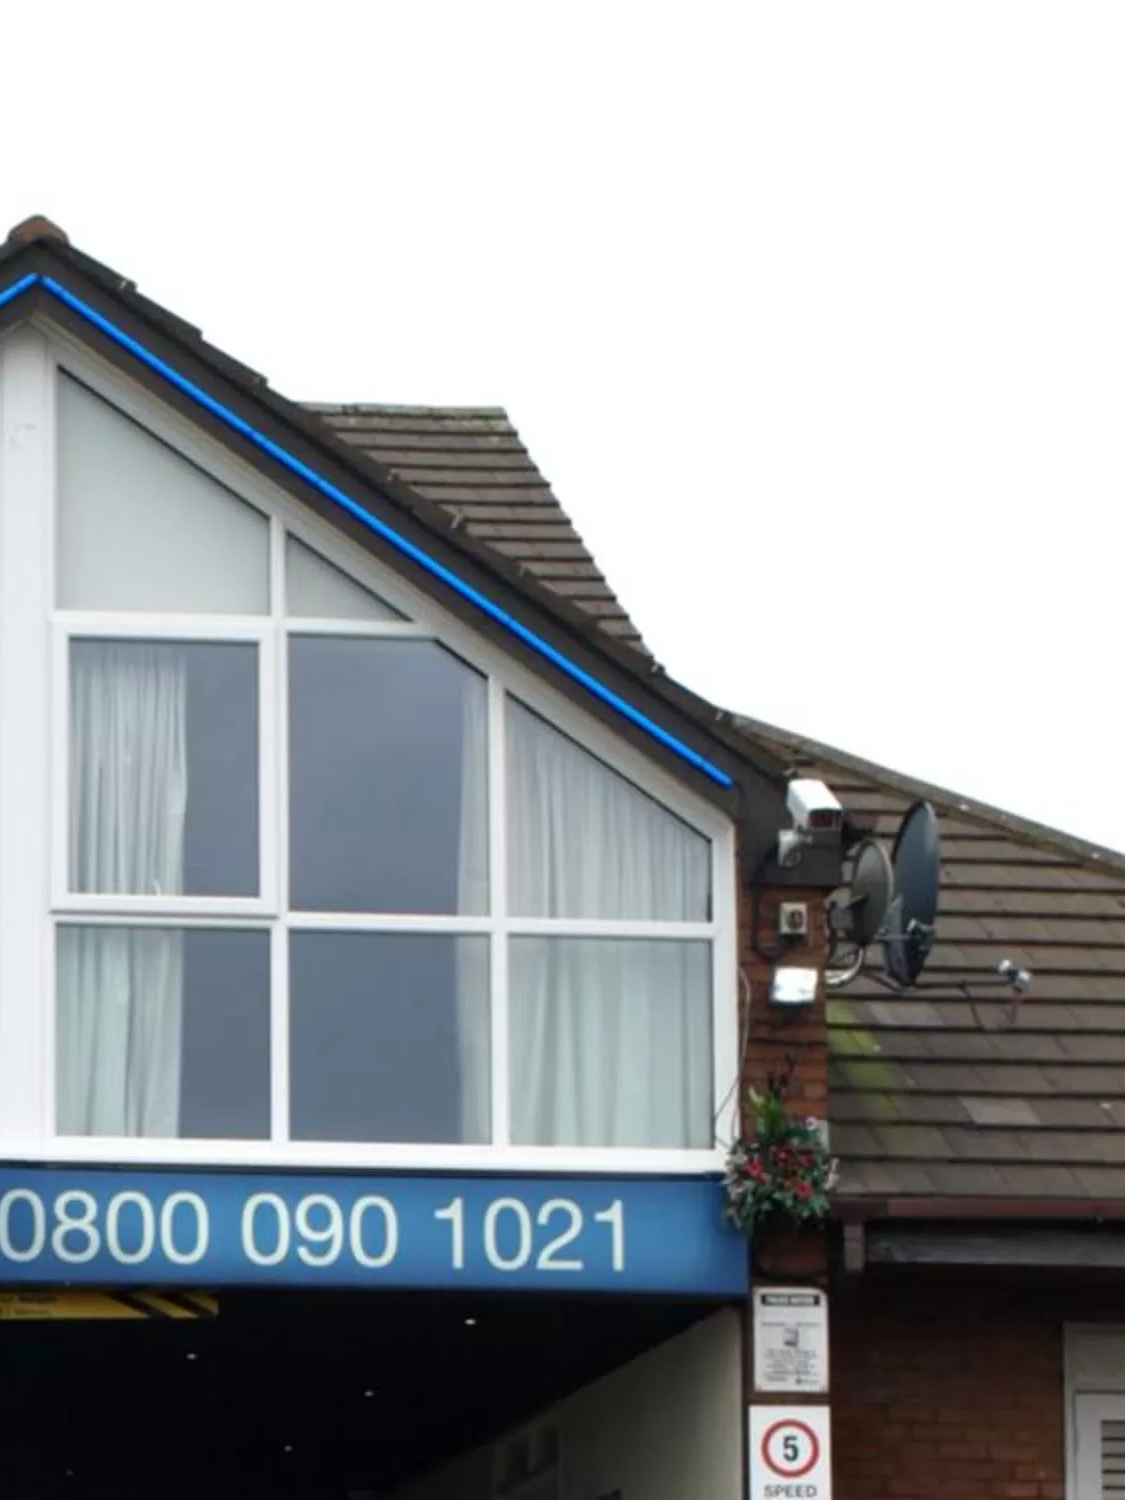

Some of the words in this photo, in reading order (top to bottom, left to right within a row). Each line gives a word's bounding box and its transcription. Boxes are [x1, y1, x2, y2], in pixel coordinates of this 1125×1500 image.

[241, 1193, 399, 1270] 090
[434, 1198, 626, 1274] 1021
[782, 1435, 800, 1462] 5
[763, 1484, 817, 1499] SPEED
